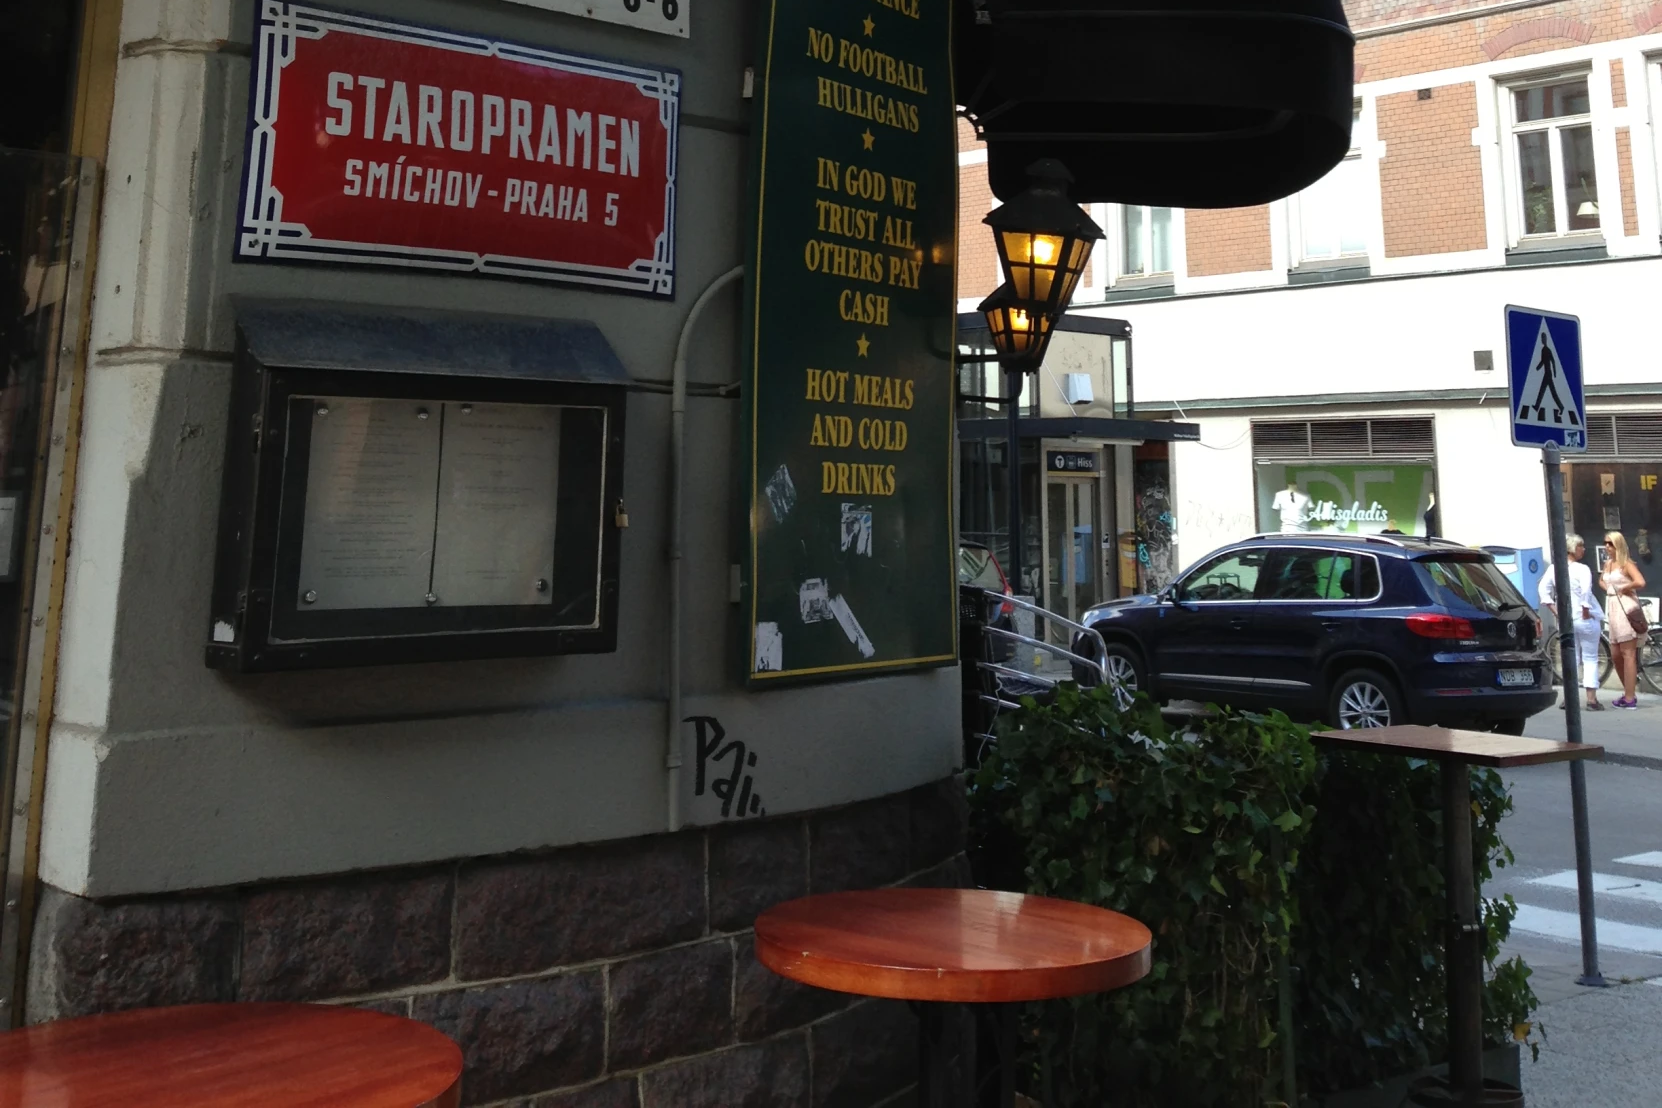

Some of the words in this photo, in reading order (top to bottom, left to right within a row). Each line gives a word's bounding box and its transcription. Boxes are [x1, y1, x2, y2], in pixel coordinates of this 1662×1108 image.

[806, 26, 833, 63] NO
[838, 38, 927, 95] FOOTBALL
[324, 71, 640, 178] STAROPRAMEN
[817, 76, 919, 133] HULLIGANS
[817, 157, 840, 191] IN
[845, 164, 886, 202] GOD
[891, 176, 916, 210] WE
[604, 193, 620, 227] 5
[816, 198, 878, 241] TRUST
[882, 215, 915, 250] ALL
[805, 239, 883, 283] OTHERS
[888, 256, 922, 290] PAY
[839, 289, 889, 326] CASH
[805, 368, 849, 403] HOT
[853, 374, 914, 410] MEALS
[810, 413, 853, 448] AND
[858, 418, 908, 451] COLD
[821, 461, 896, 496] DRINKS
[1077, 457, 1093, 468] Hiss
[1640, 475, 1658, 490] IF
